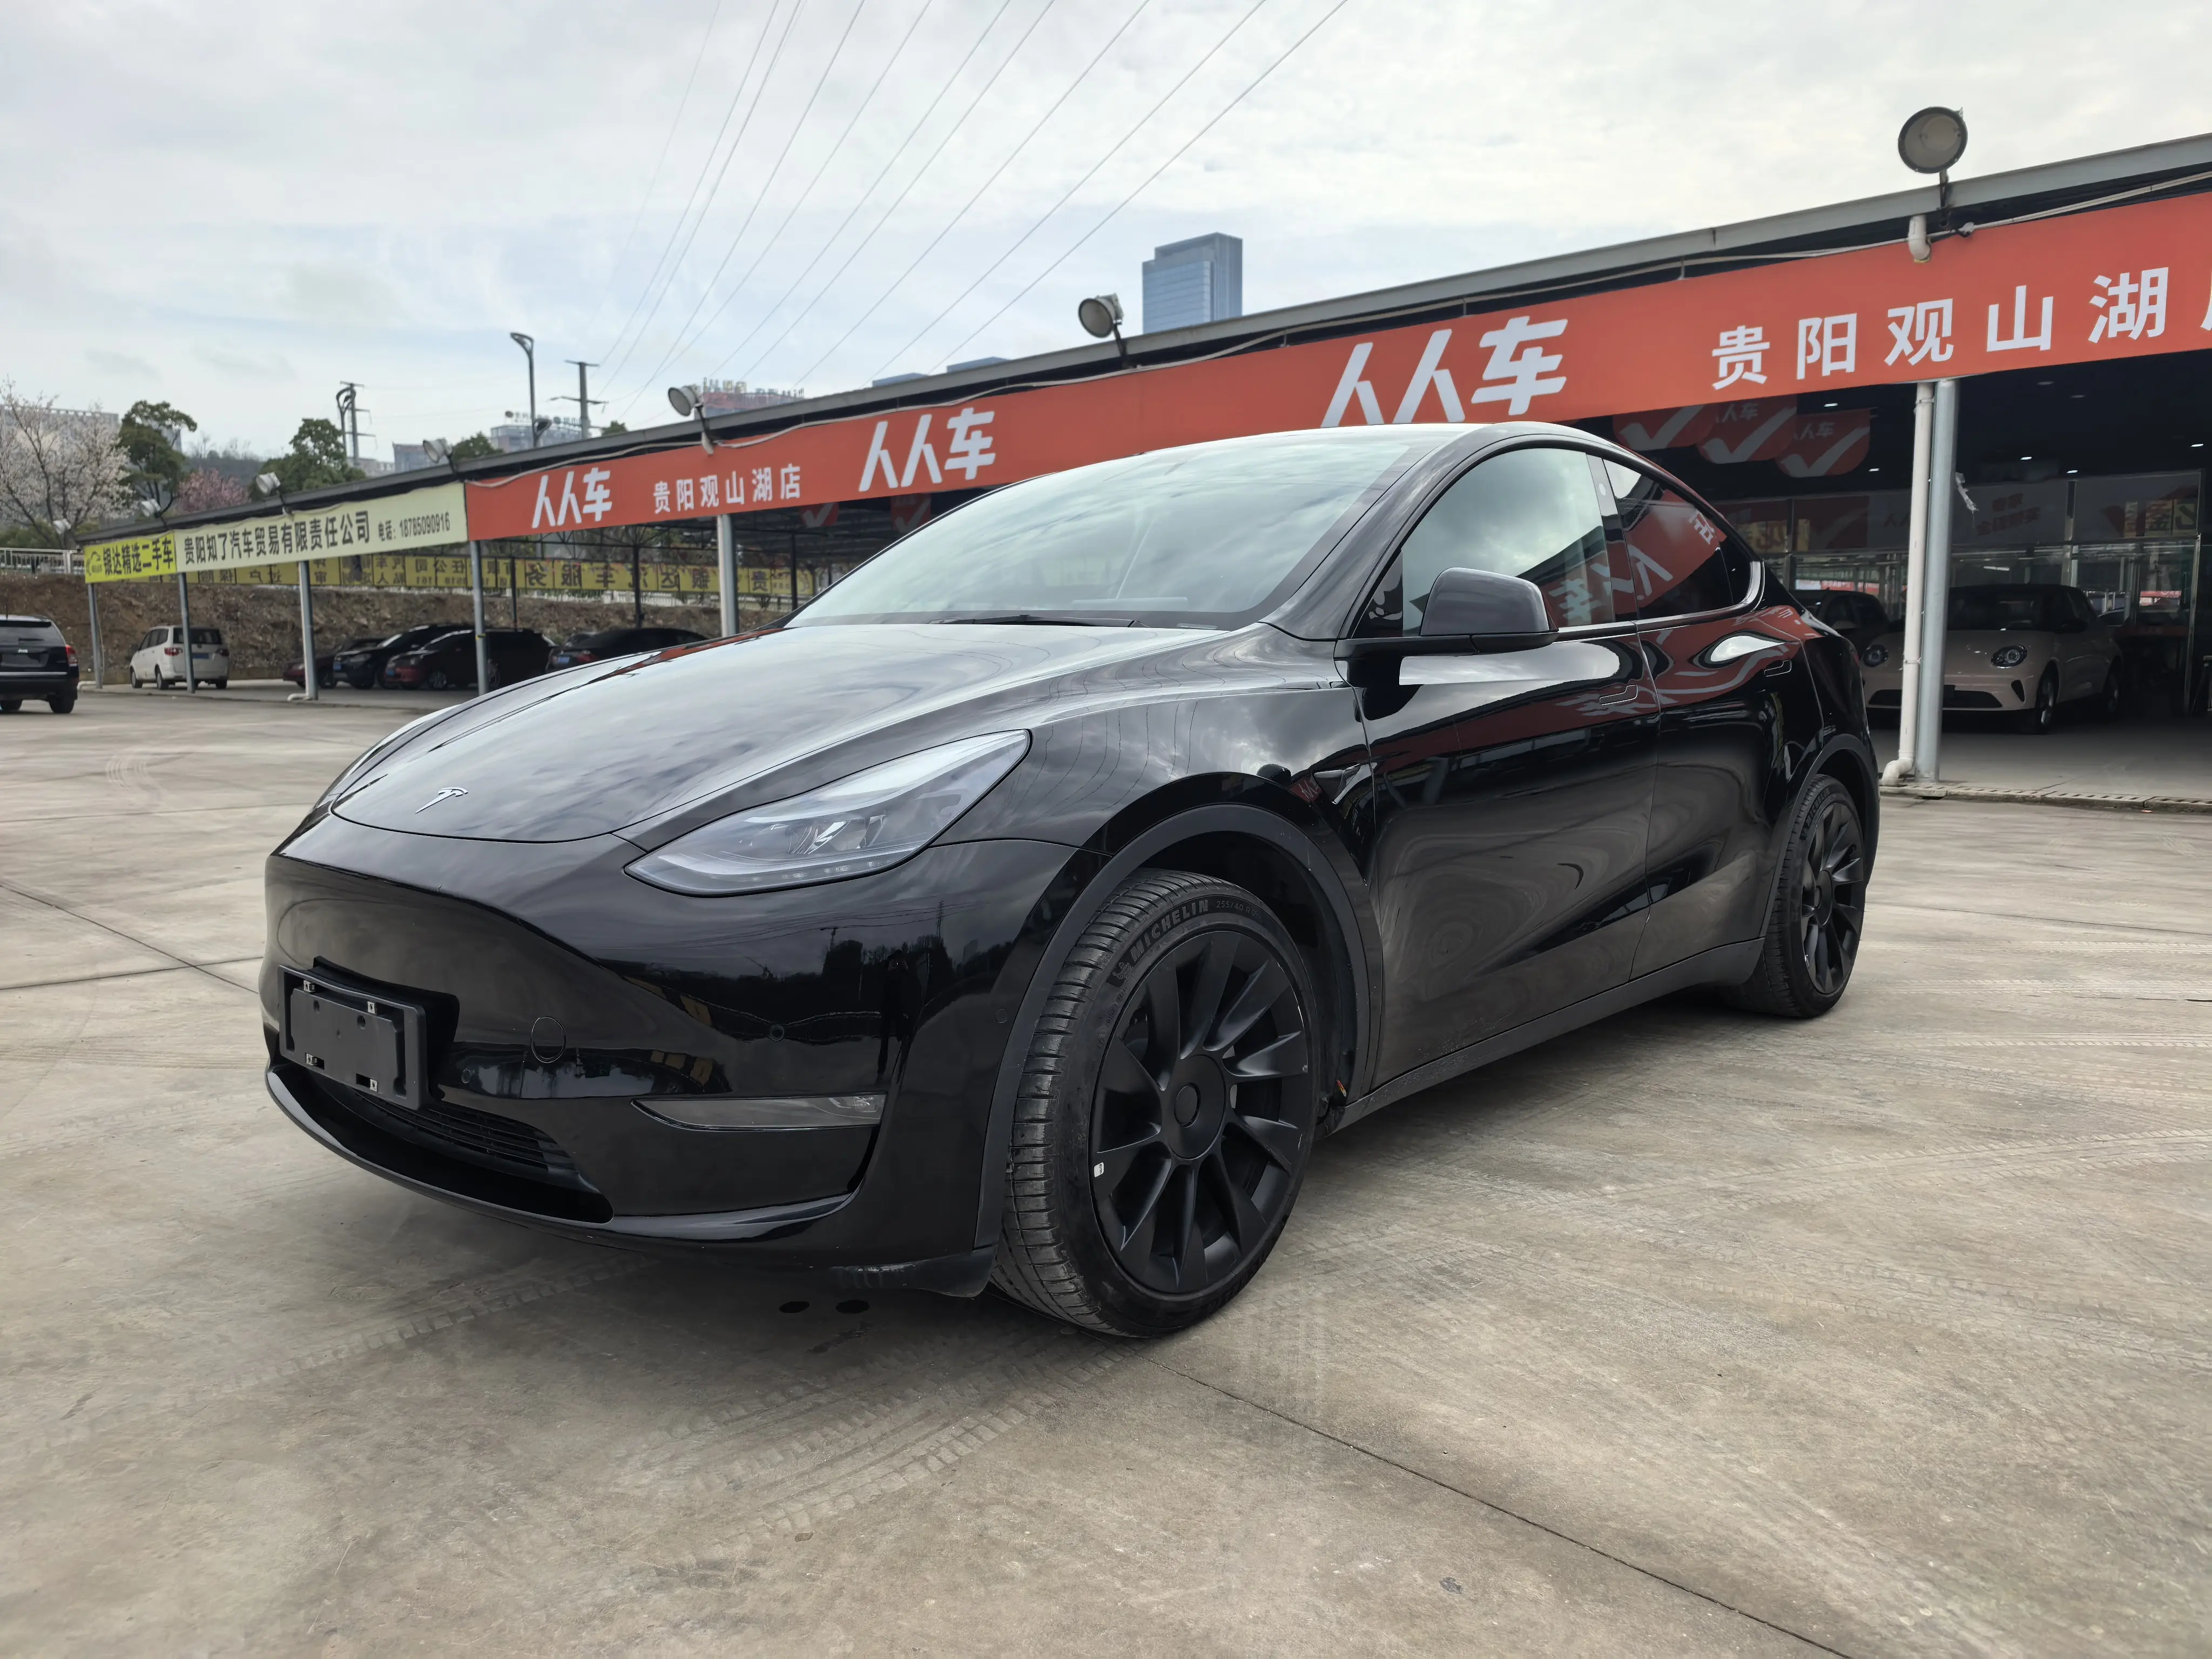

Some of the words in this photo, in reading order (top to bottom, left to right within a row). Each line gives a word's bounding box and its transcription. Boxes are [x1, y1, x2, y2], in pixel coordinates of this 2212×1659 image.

[1320, 315, 1568, 428] 人人车
[1712, 267, 2212, 390] 贵阳观山湖
[858, 408, 996, 492] 人人车
[532, 467, 612, 528] 人人车
[653, 464, 801, 514] 贵阳观山湖店
[103, 536, 173, 576] 银达精选二手车
[184, 510, 370, 565] 贵阳知了汽车贸易有限责任公司
[399, 511, 450, 538] 18785090916
[1129, 899, 1209, 962] MICHELIN
